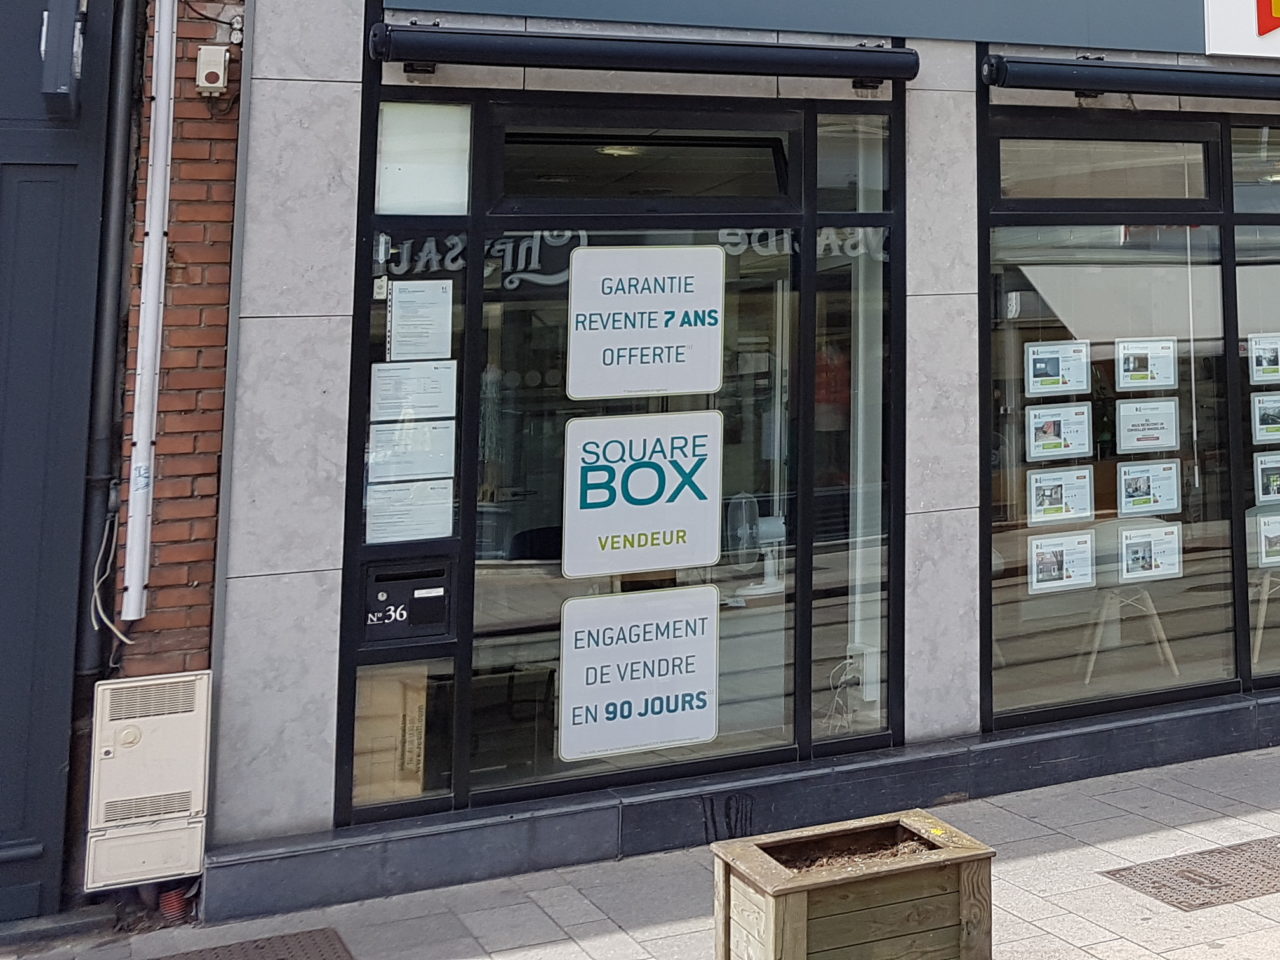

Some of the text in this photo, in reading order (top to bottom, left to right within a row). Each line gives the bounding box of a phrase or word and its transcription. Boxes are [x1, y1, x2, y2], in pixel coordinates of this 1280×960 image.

[601, 275, 696, 295] GARANTIE
[574, 309, 719, 331] REVENTE 7 ANS
[602, 345, 686, 367] OFFERTE
[581, 434, 709, 465] SQUARE
[579, 457, 708, 510] BOX
[598, 529, 687, 551] VENDEUR
[384, 604, 408, 623] 36
[574, 616, 708, 650] ENGAGEMENT
[585, 655, 696, 686] DE VENDRE
[571, 690, 708, 726] EN 90 JOURS
